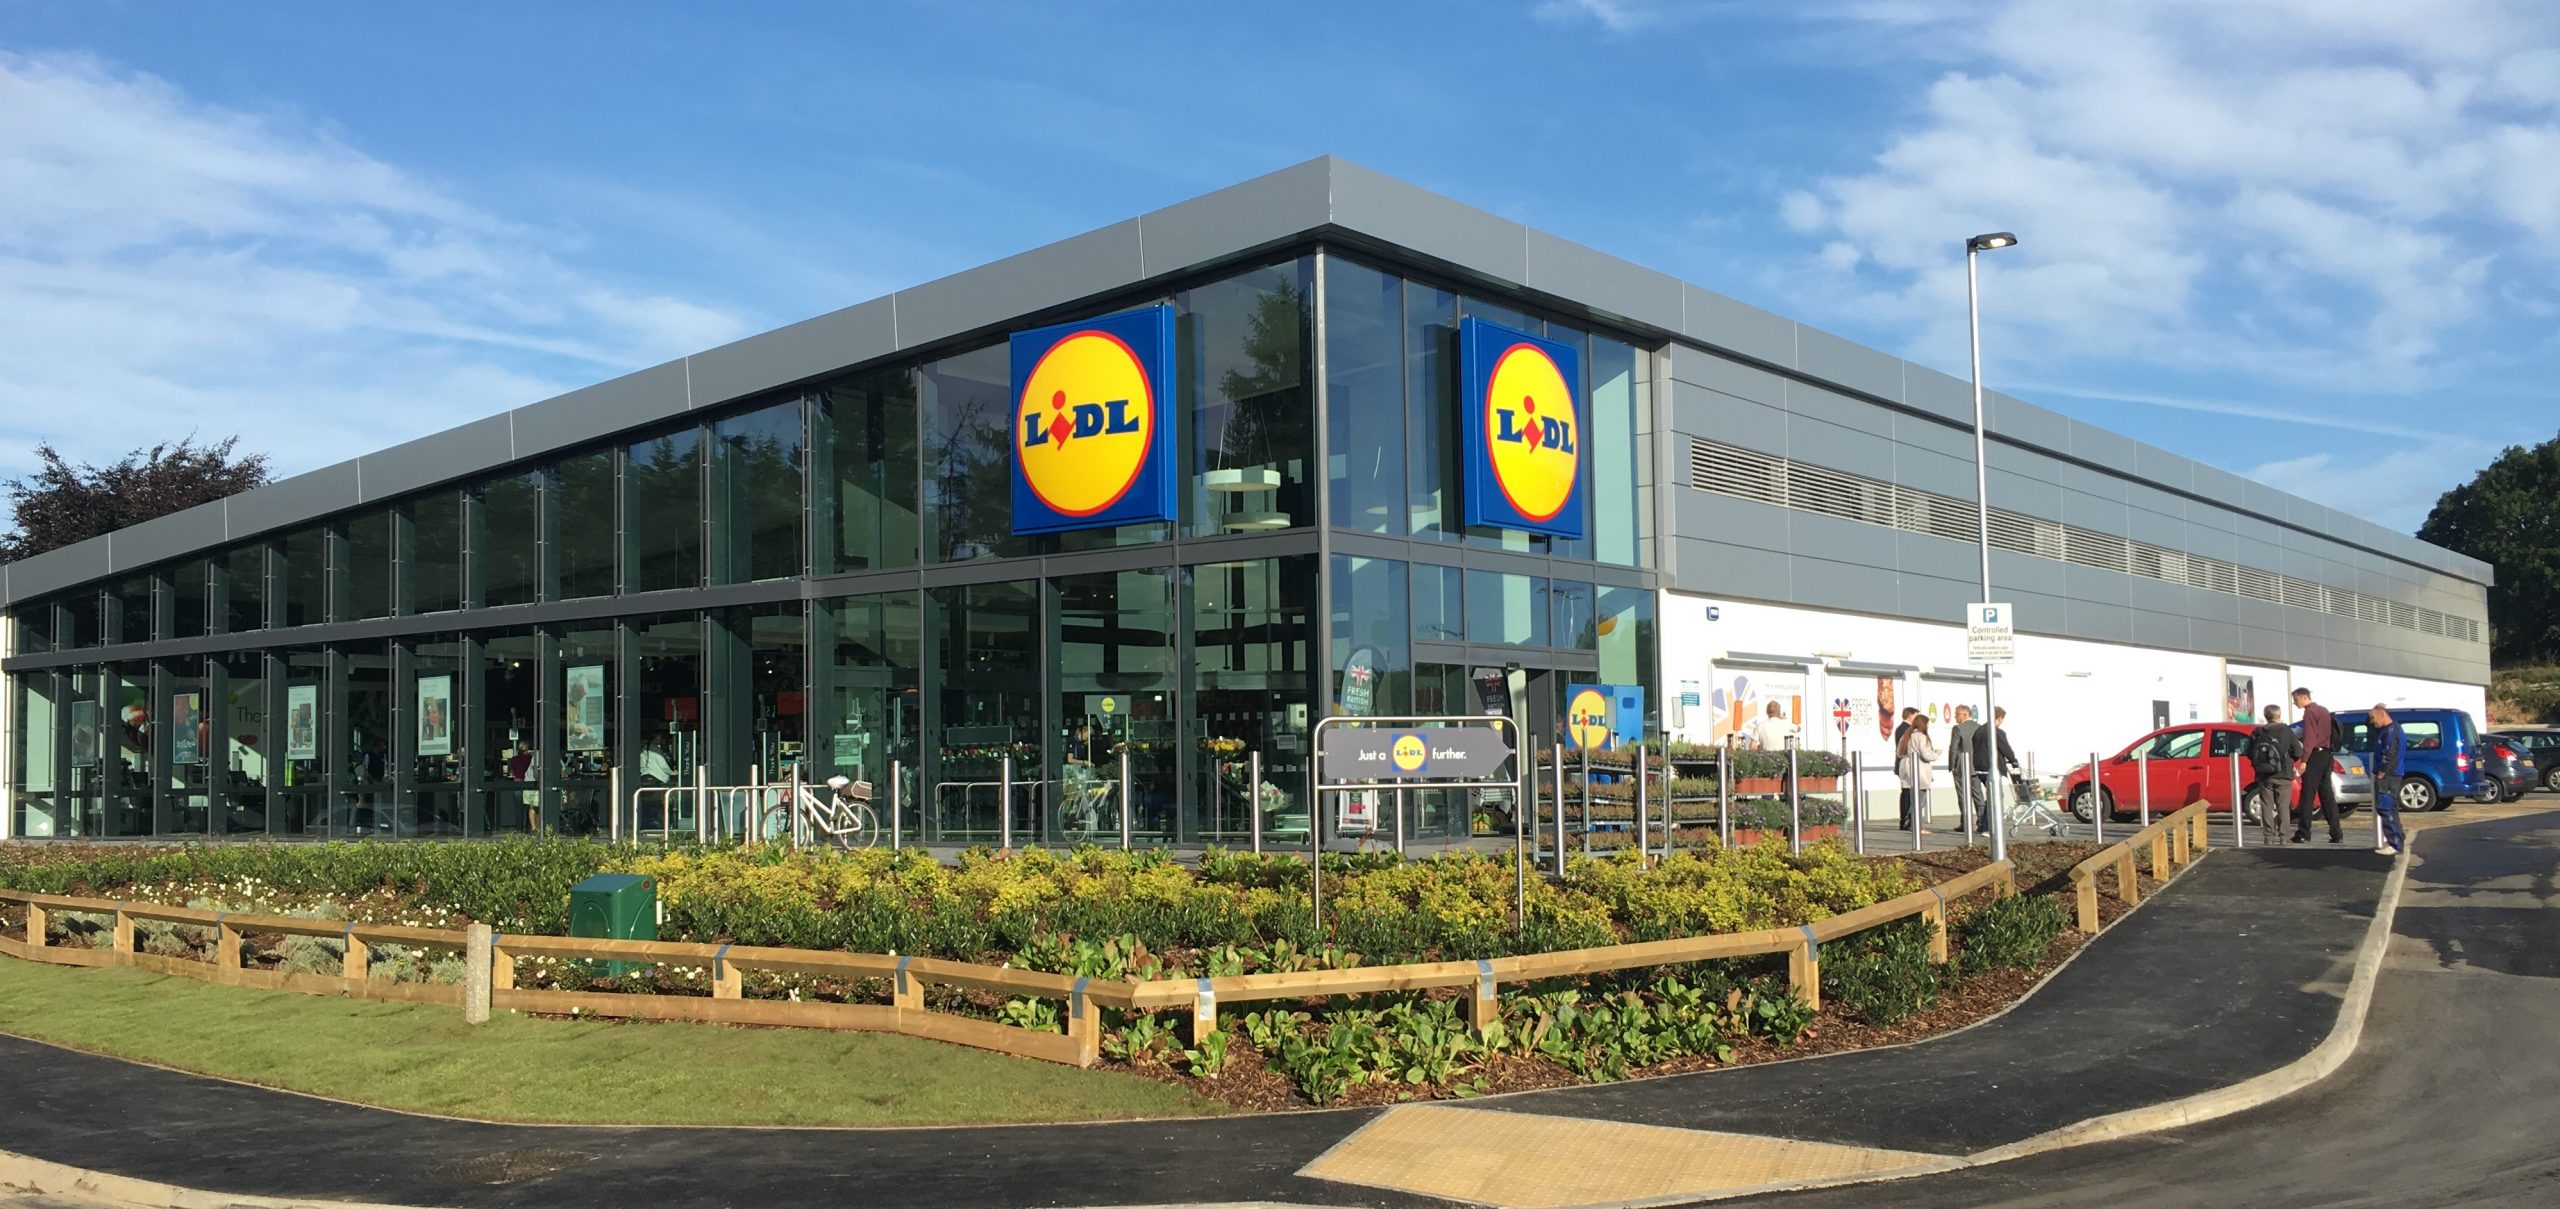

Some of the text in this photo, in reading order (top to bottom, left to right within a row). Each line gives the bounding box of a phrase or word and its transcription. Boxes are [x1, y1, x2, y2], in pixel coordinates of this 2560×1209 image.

[1985, 609, 1996, 622] P
[1969, 635, 1995, 643] parking
[1347, 686, 1370, 697] FRESH
[1358, 749, 1377, 761] Just
[1379, 752, 1386, 761] a
[1432, 747, 1467, 760] further.
